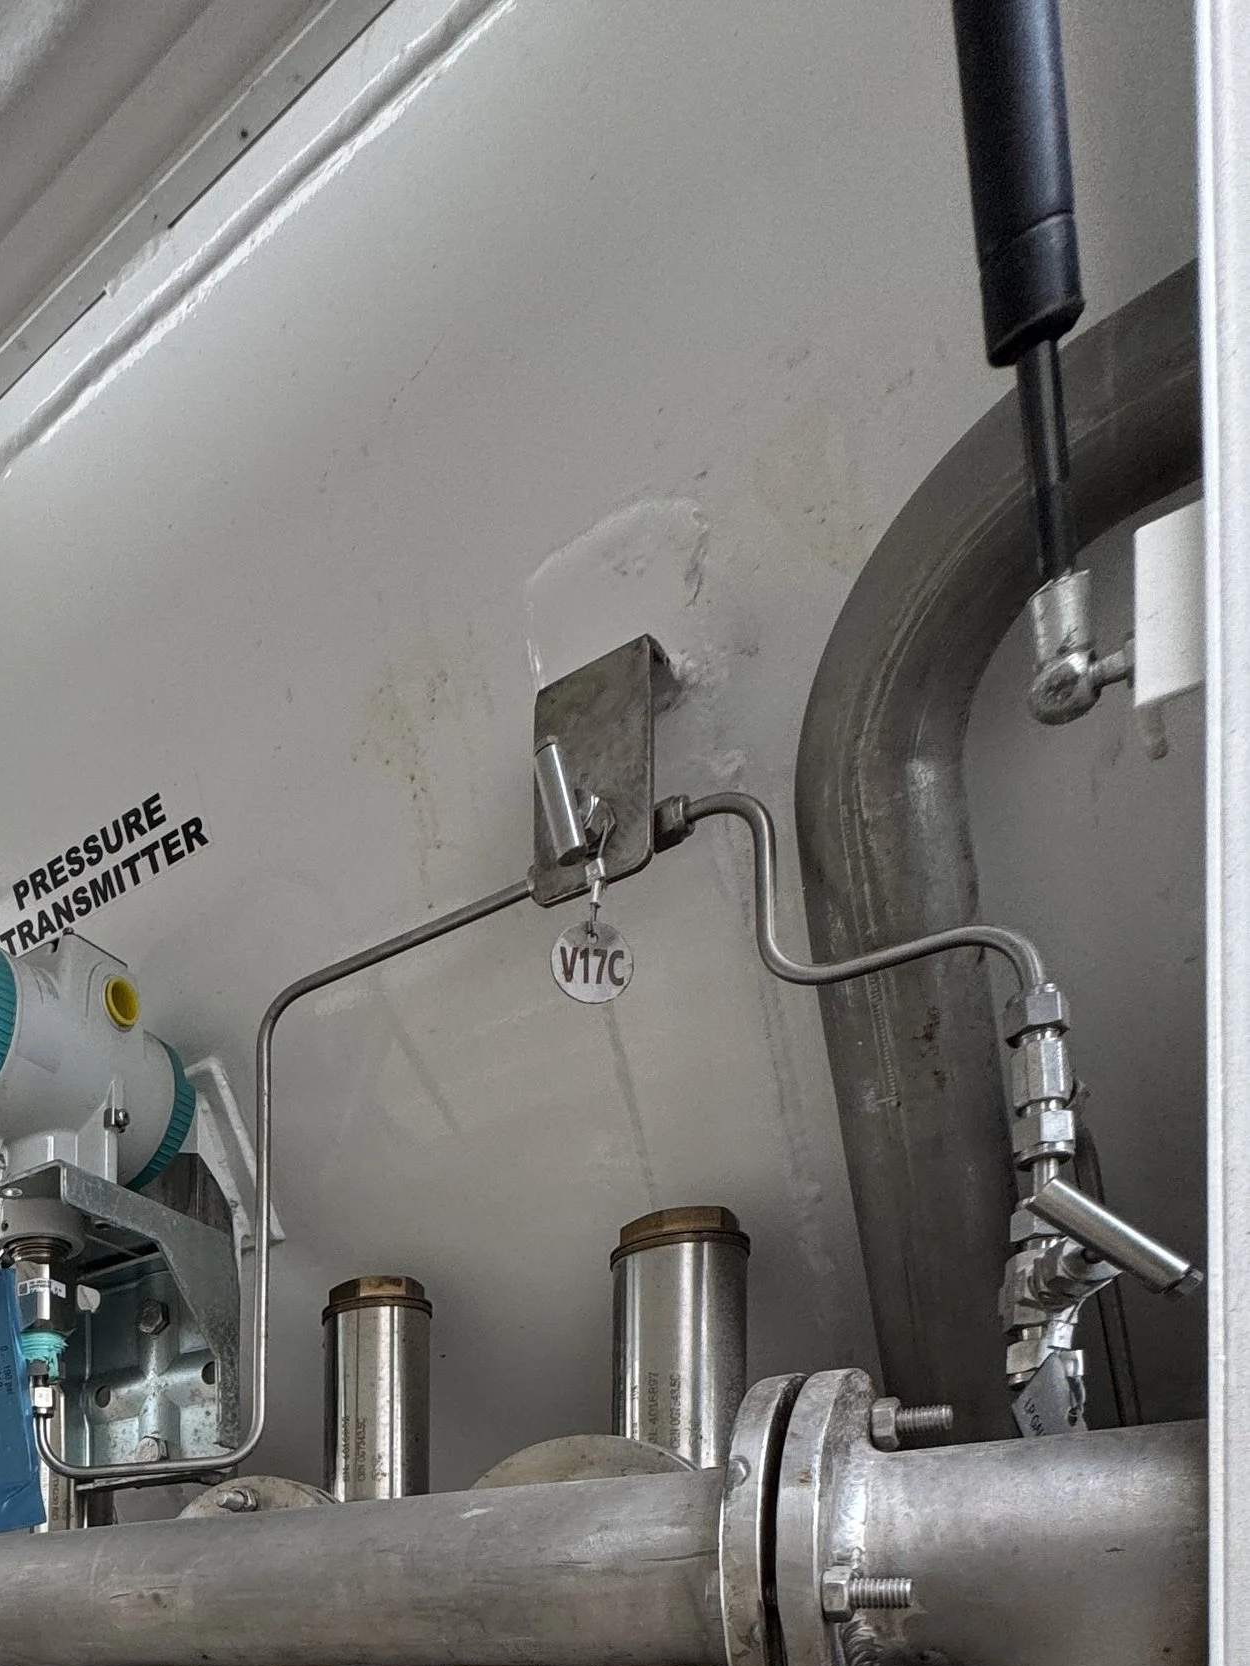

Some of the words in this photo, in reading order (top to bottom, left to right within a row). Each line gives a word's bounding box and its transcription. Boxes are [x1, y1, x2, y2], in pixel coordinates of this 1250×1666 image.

[0, 816, 210, 957] TRANSMITTER
[12, 792, 167, 911] PRESSURE
[560, 946, 625, 986] V17C
